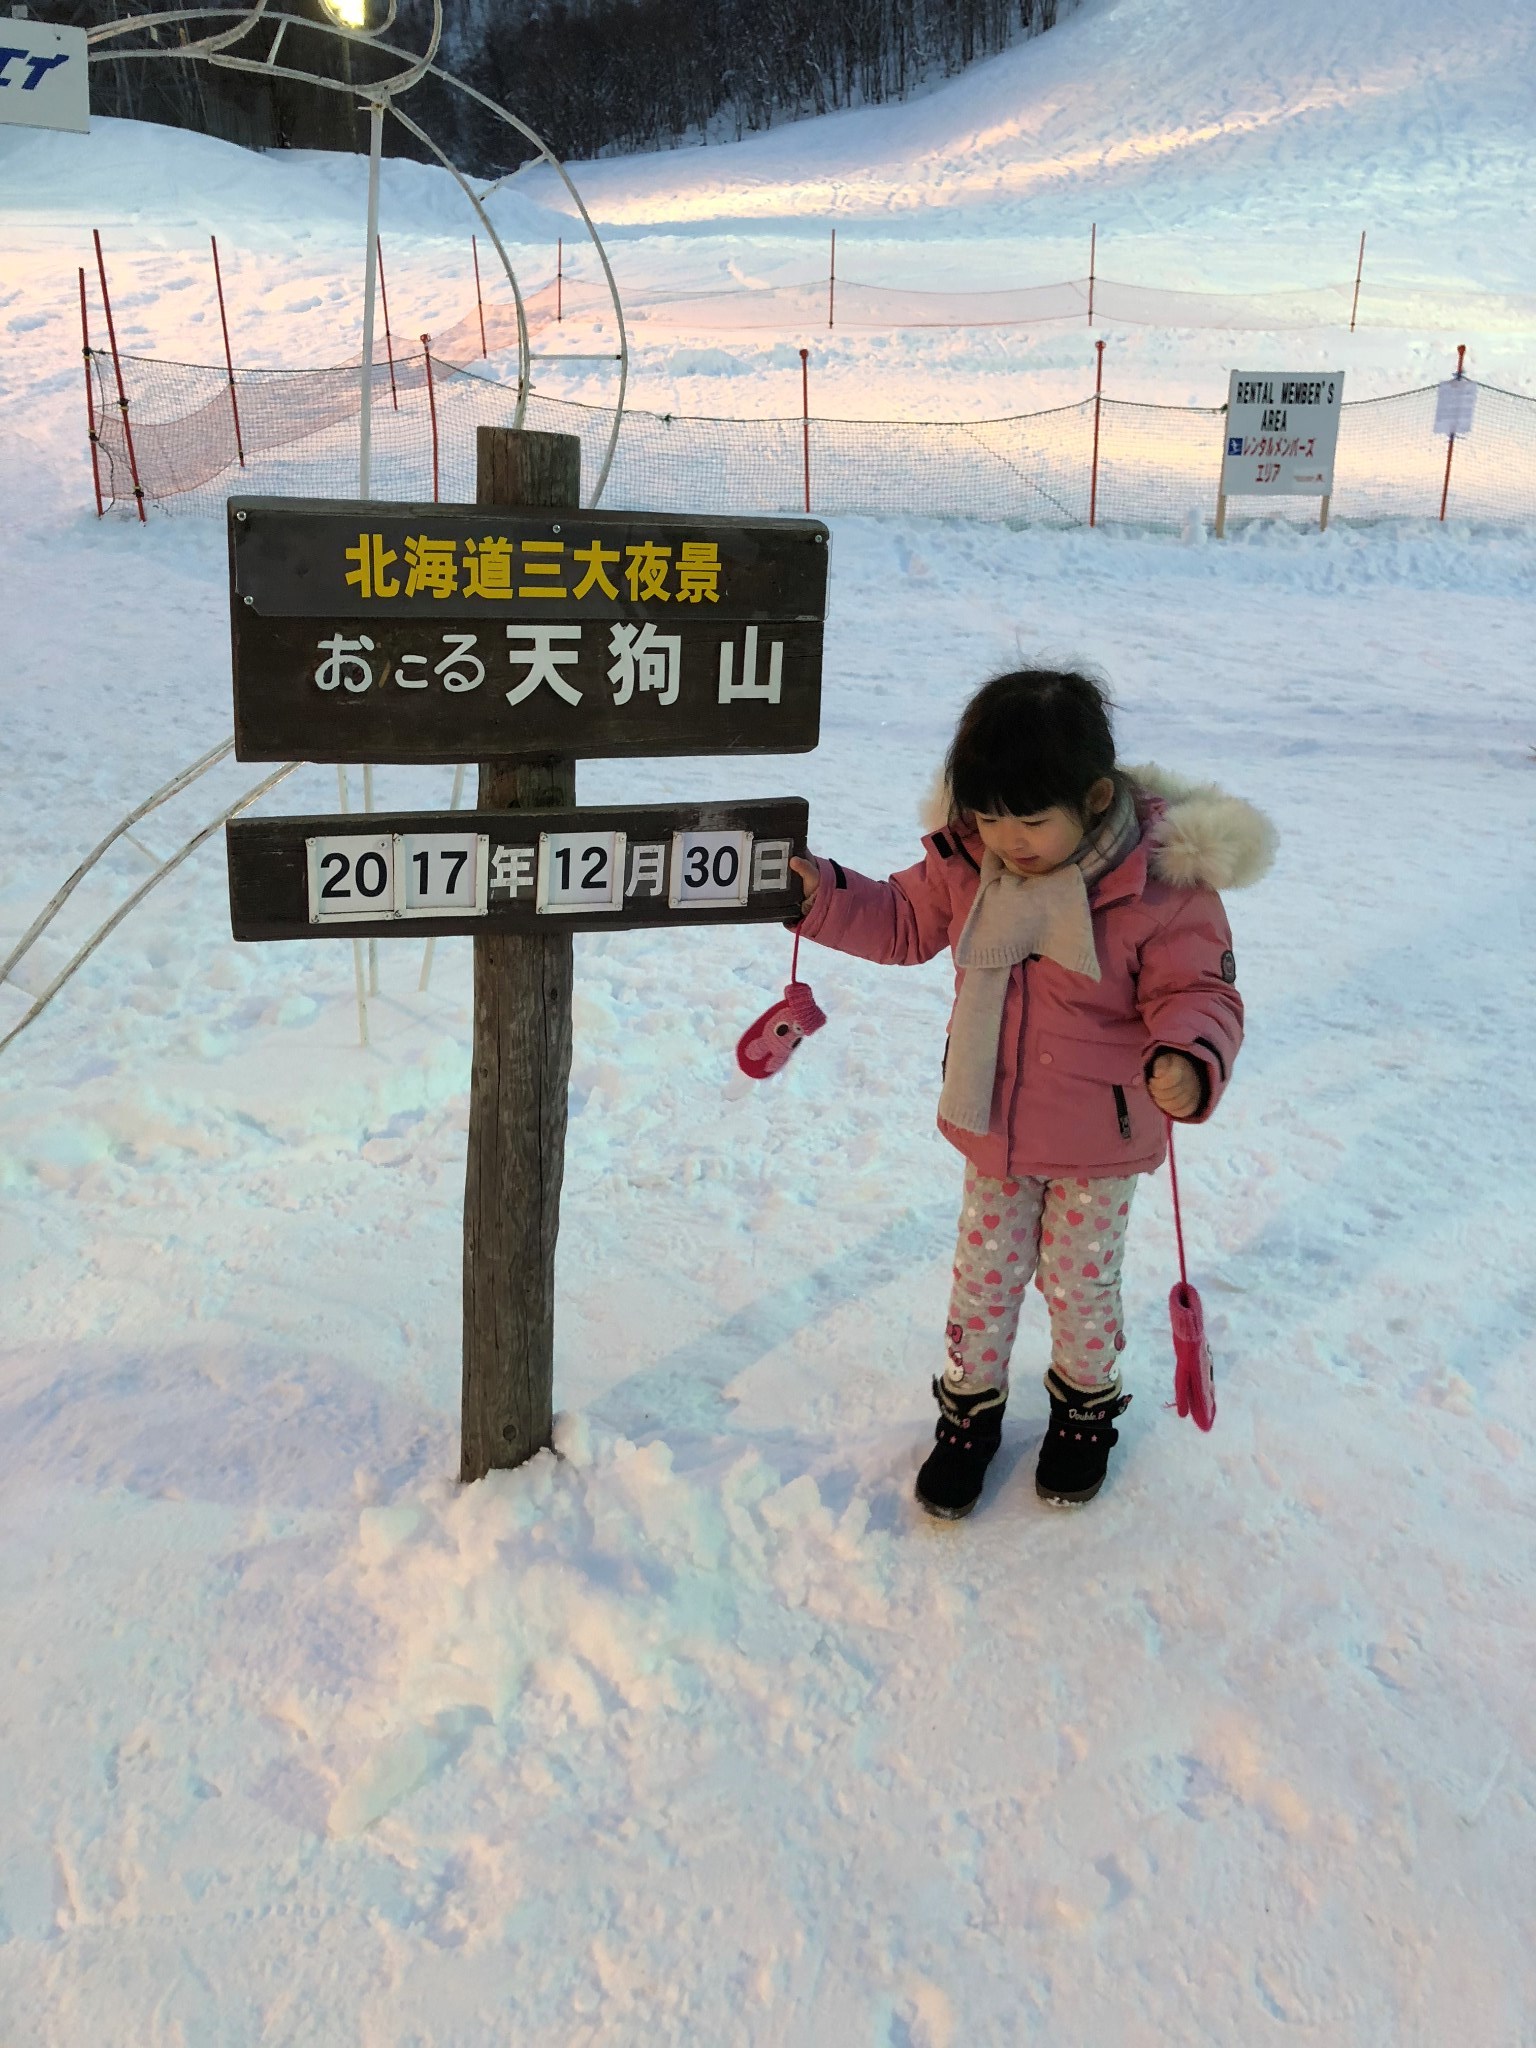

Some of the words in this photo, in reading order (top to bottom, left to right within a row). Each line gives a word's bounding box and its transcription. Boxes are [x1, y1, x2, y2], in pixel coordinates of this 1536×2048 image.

[1237, 382, 1273, 404] RENTAL
[1281, 380, 1335, 404] MEMBER'S
[1261, 410, 1287, 431] AREA
[1256, 464, 1281, 482] エリア
[345, 534, 721, 603] 北海道三大夜景
